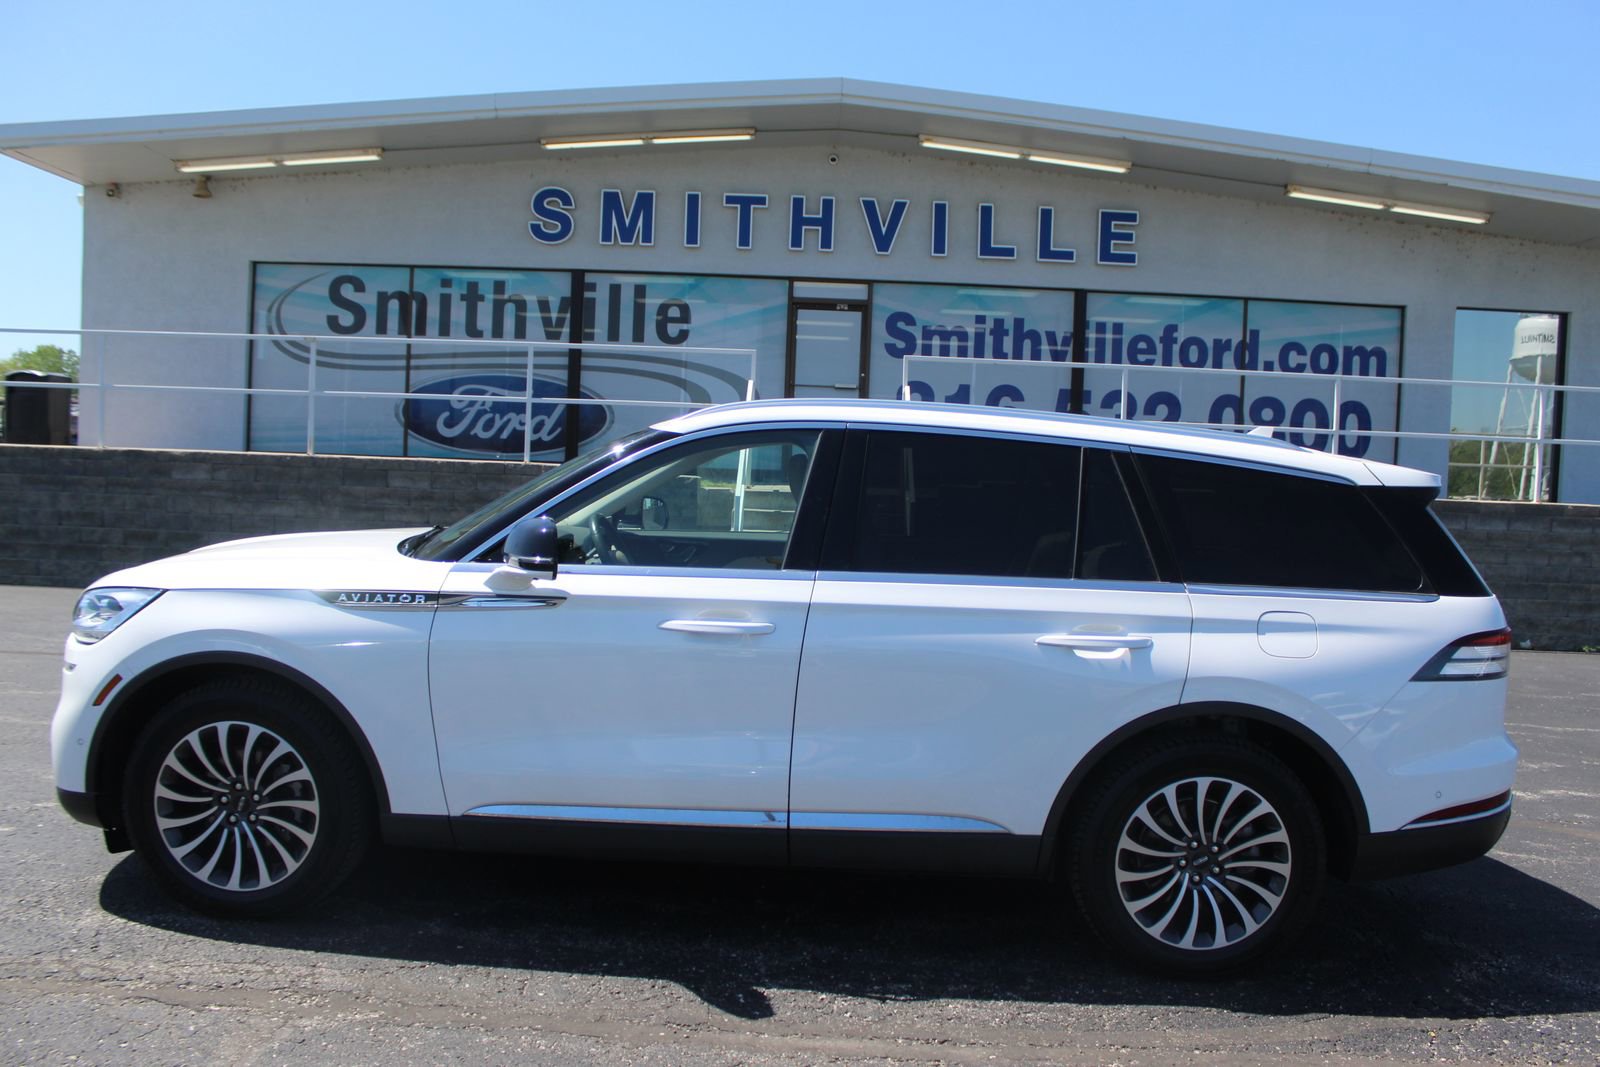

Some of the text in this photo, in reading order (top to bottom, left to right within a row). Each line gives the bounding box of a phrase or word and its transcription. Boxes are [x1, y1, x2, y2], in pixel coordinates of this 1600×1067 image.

[528, 186, 1140, 266] SMITHVILLE
[326, 275, 692, 345] Smithville
[437, 384, 563, 442] Ford
[337, 593, 427, 604] AVIATOR
